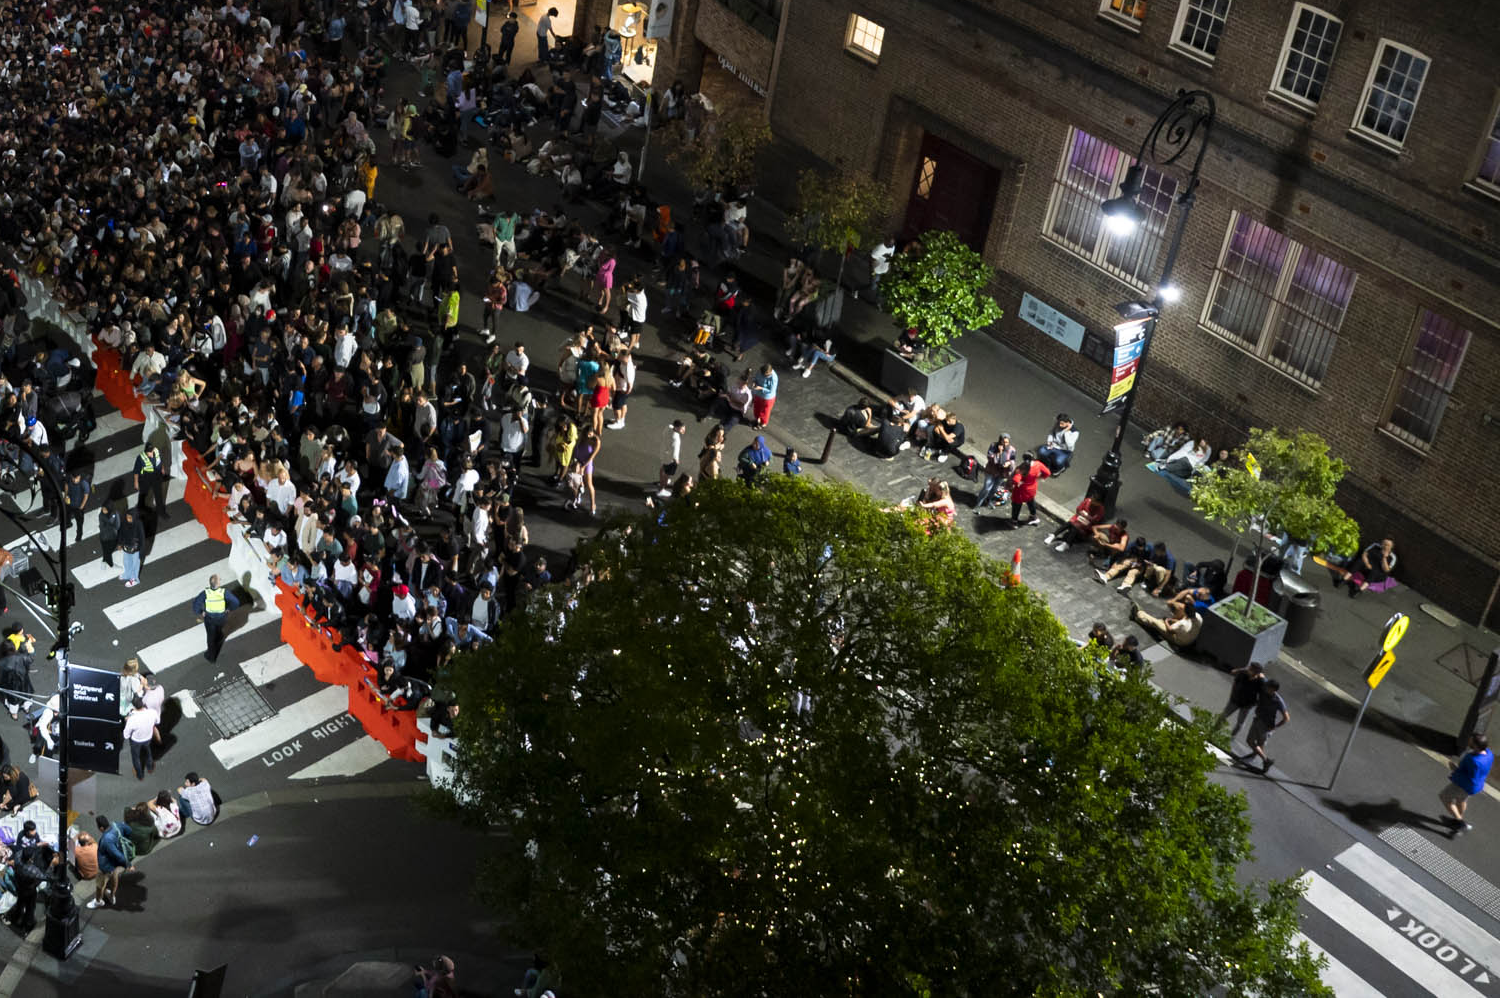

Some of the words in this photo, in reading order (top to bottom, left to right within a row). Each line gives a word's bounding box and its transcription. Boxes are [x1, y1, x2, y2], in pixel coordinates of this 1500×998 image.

[73, 683, 103, 693] Wynyard
[73, 694, 98, 702] Central
[262, 740, 303, 768] LOOK
[1398, 918, 1477, 975] LOOK
